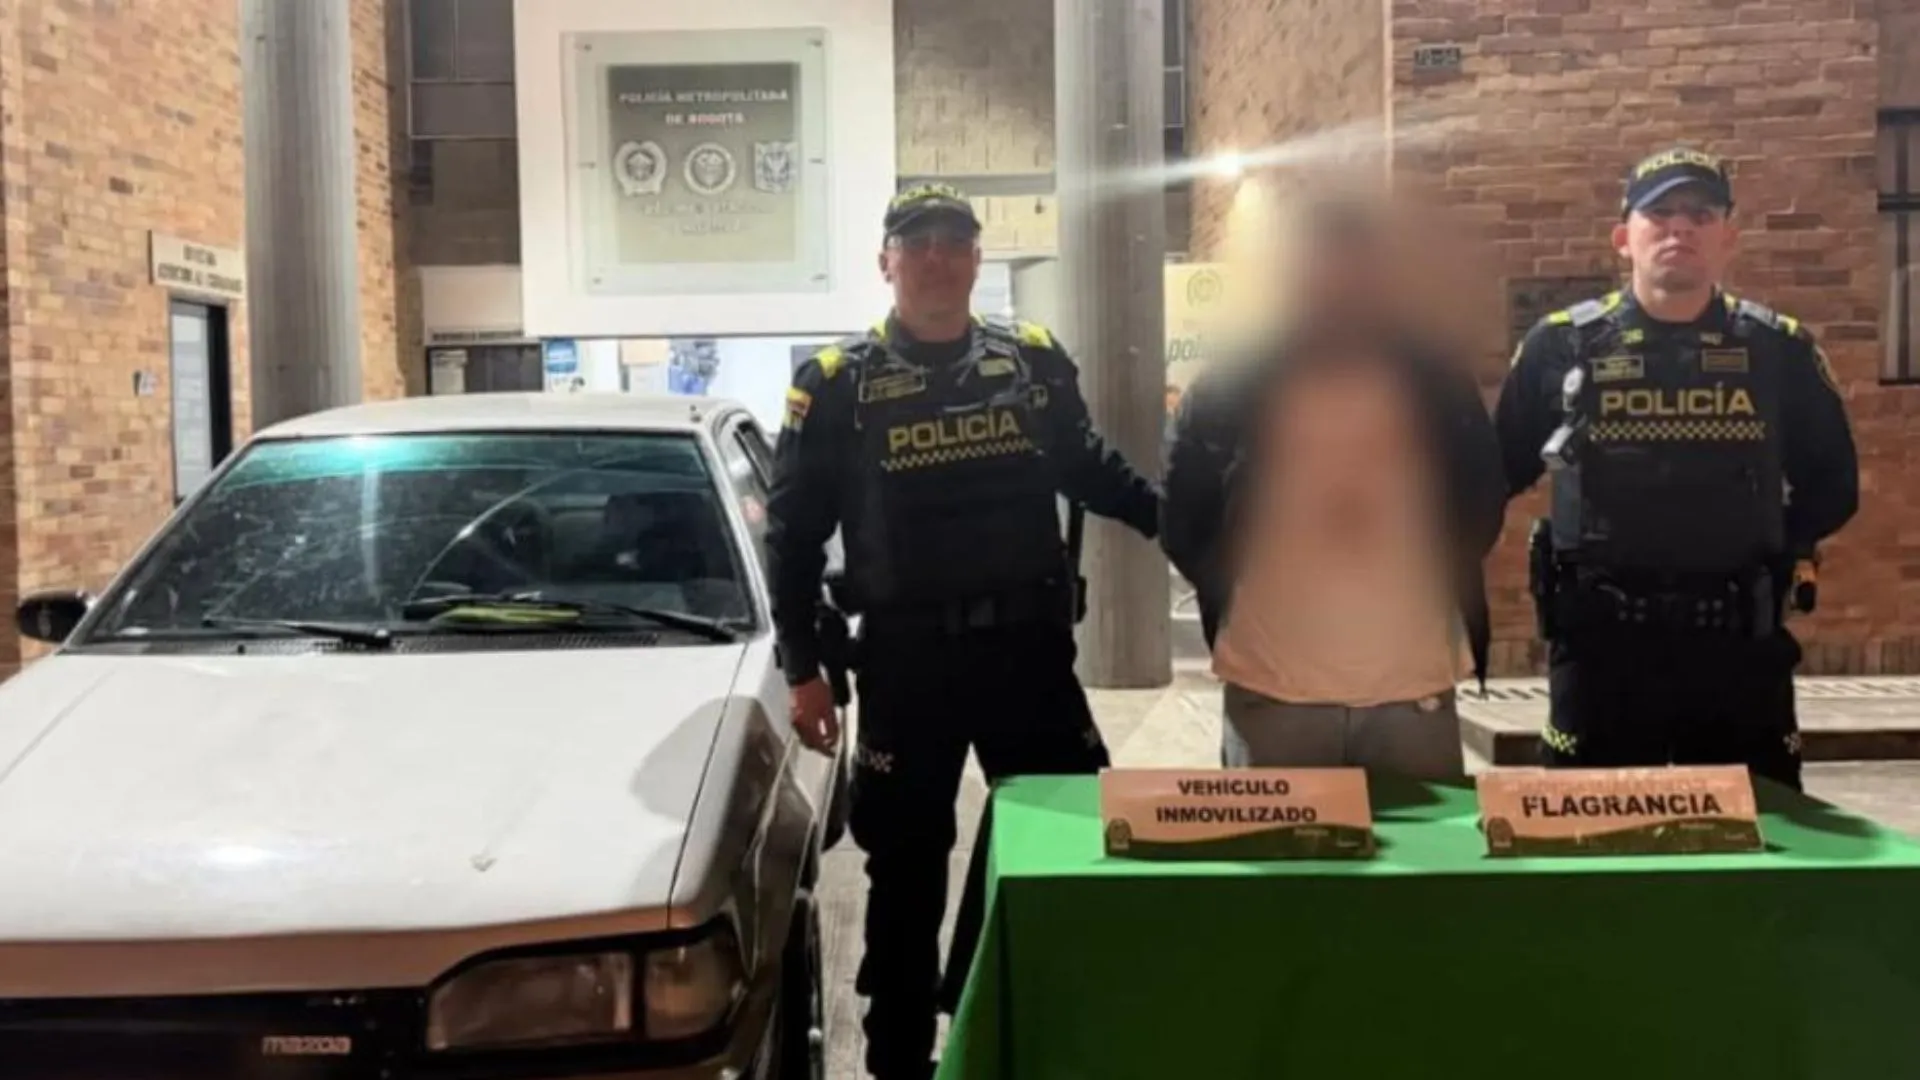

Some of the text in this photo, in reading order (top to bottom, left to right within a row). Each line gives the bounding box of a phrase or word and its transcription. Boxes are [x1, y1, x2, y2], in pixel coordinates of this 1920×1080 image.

[665, 113, 682, 125] DE
[1601, 382, 1755, 416] POLICÍA
[887, 406, 1021, 453] POLICÍA
[1177, 777, 1290, 796] VEHÍCULO
[1156, 806, 1317, 824] INMOVILIZADO
[1522, 794, 1722, 817] FLAGRANCIA
